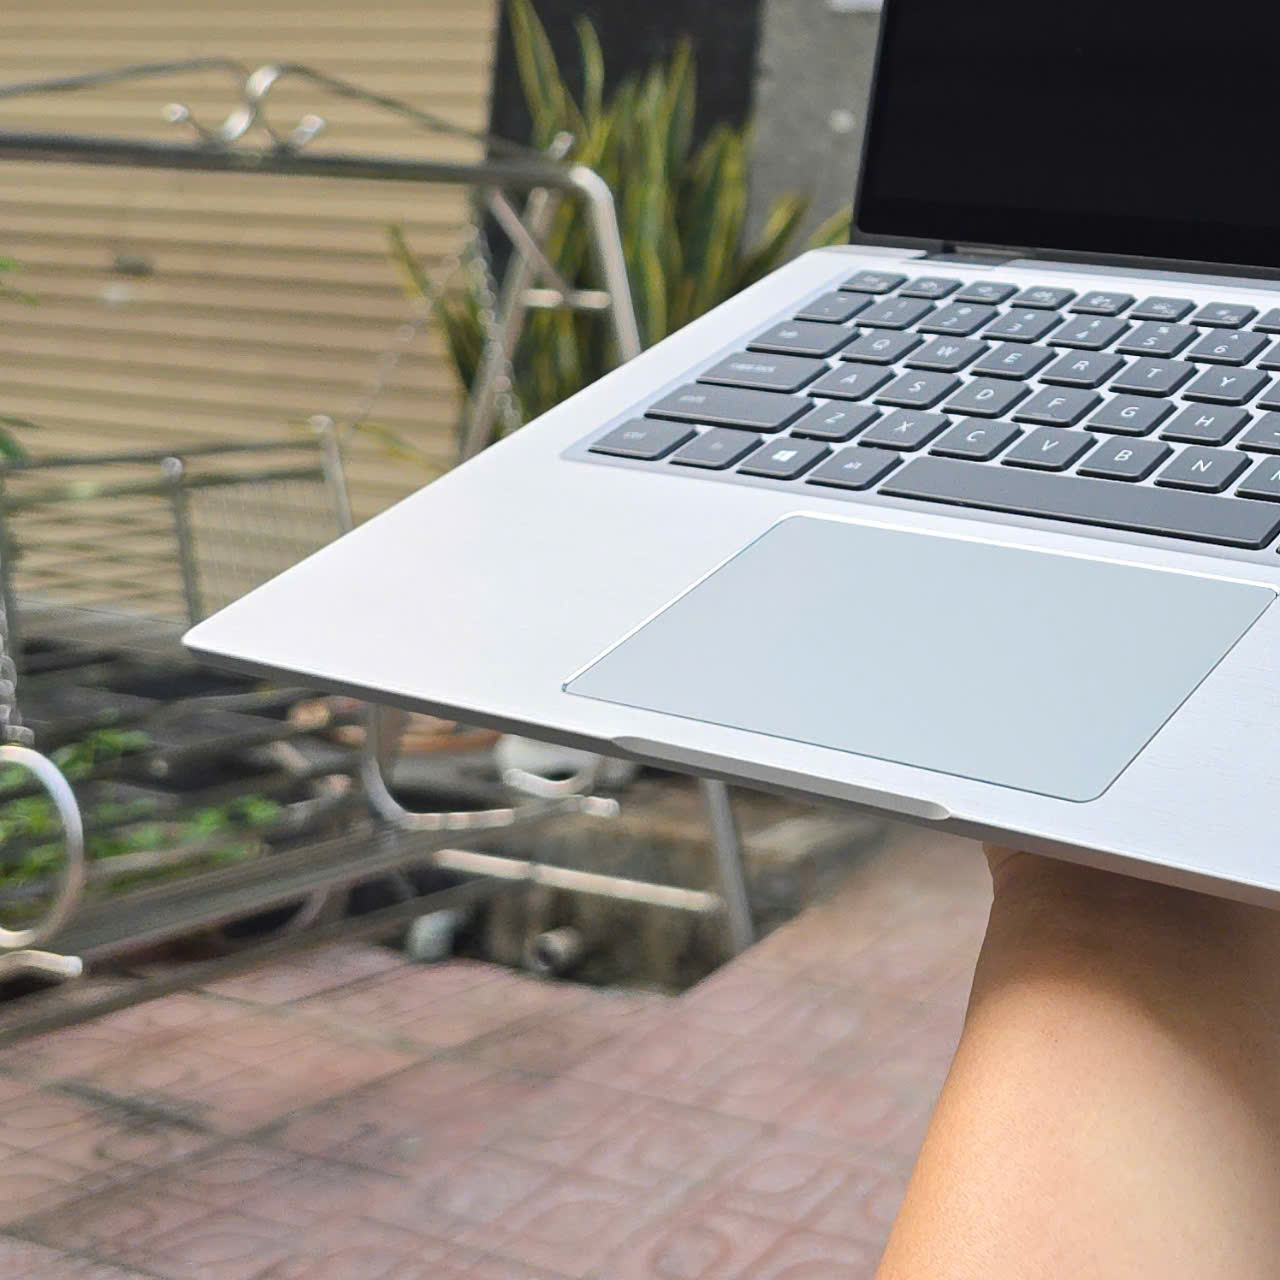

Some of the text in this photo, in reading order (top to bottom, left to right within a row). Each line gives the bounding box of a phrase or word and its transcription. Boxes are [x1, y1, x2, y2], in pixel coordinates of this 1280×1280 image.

[1214, 345, 1229, 354] 6
[1003, 353, 1022, 363] E
[1072, 361, 1089, 370] R
[1148, 368, 1162, 377] T
[840, 374, 857, 383] A
[1221, 377, 1236, 386] Y
[909, 381, 925, 392] S
[976, 389, 994, 399] D
[1048, 398, 1066, 407] F
[1121, 407, 1139, 417] G
[1195, 416, 1214, 426] H
[895, 421, 914, 432] X
[967, 431, 985, 441] C
[1042, 440, 1059, 451] V
[1114, 450, 1132, 461] B
[1192, 460, 1212, 472] N
